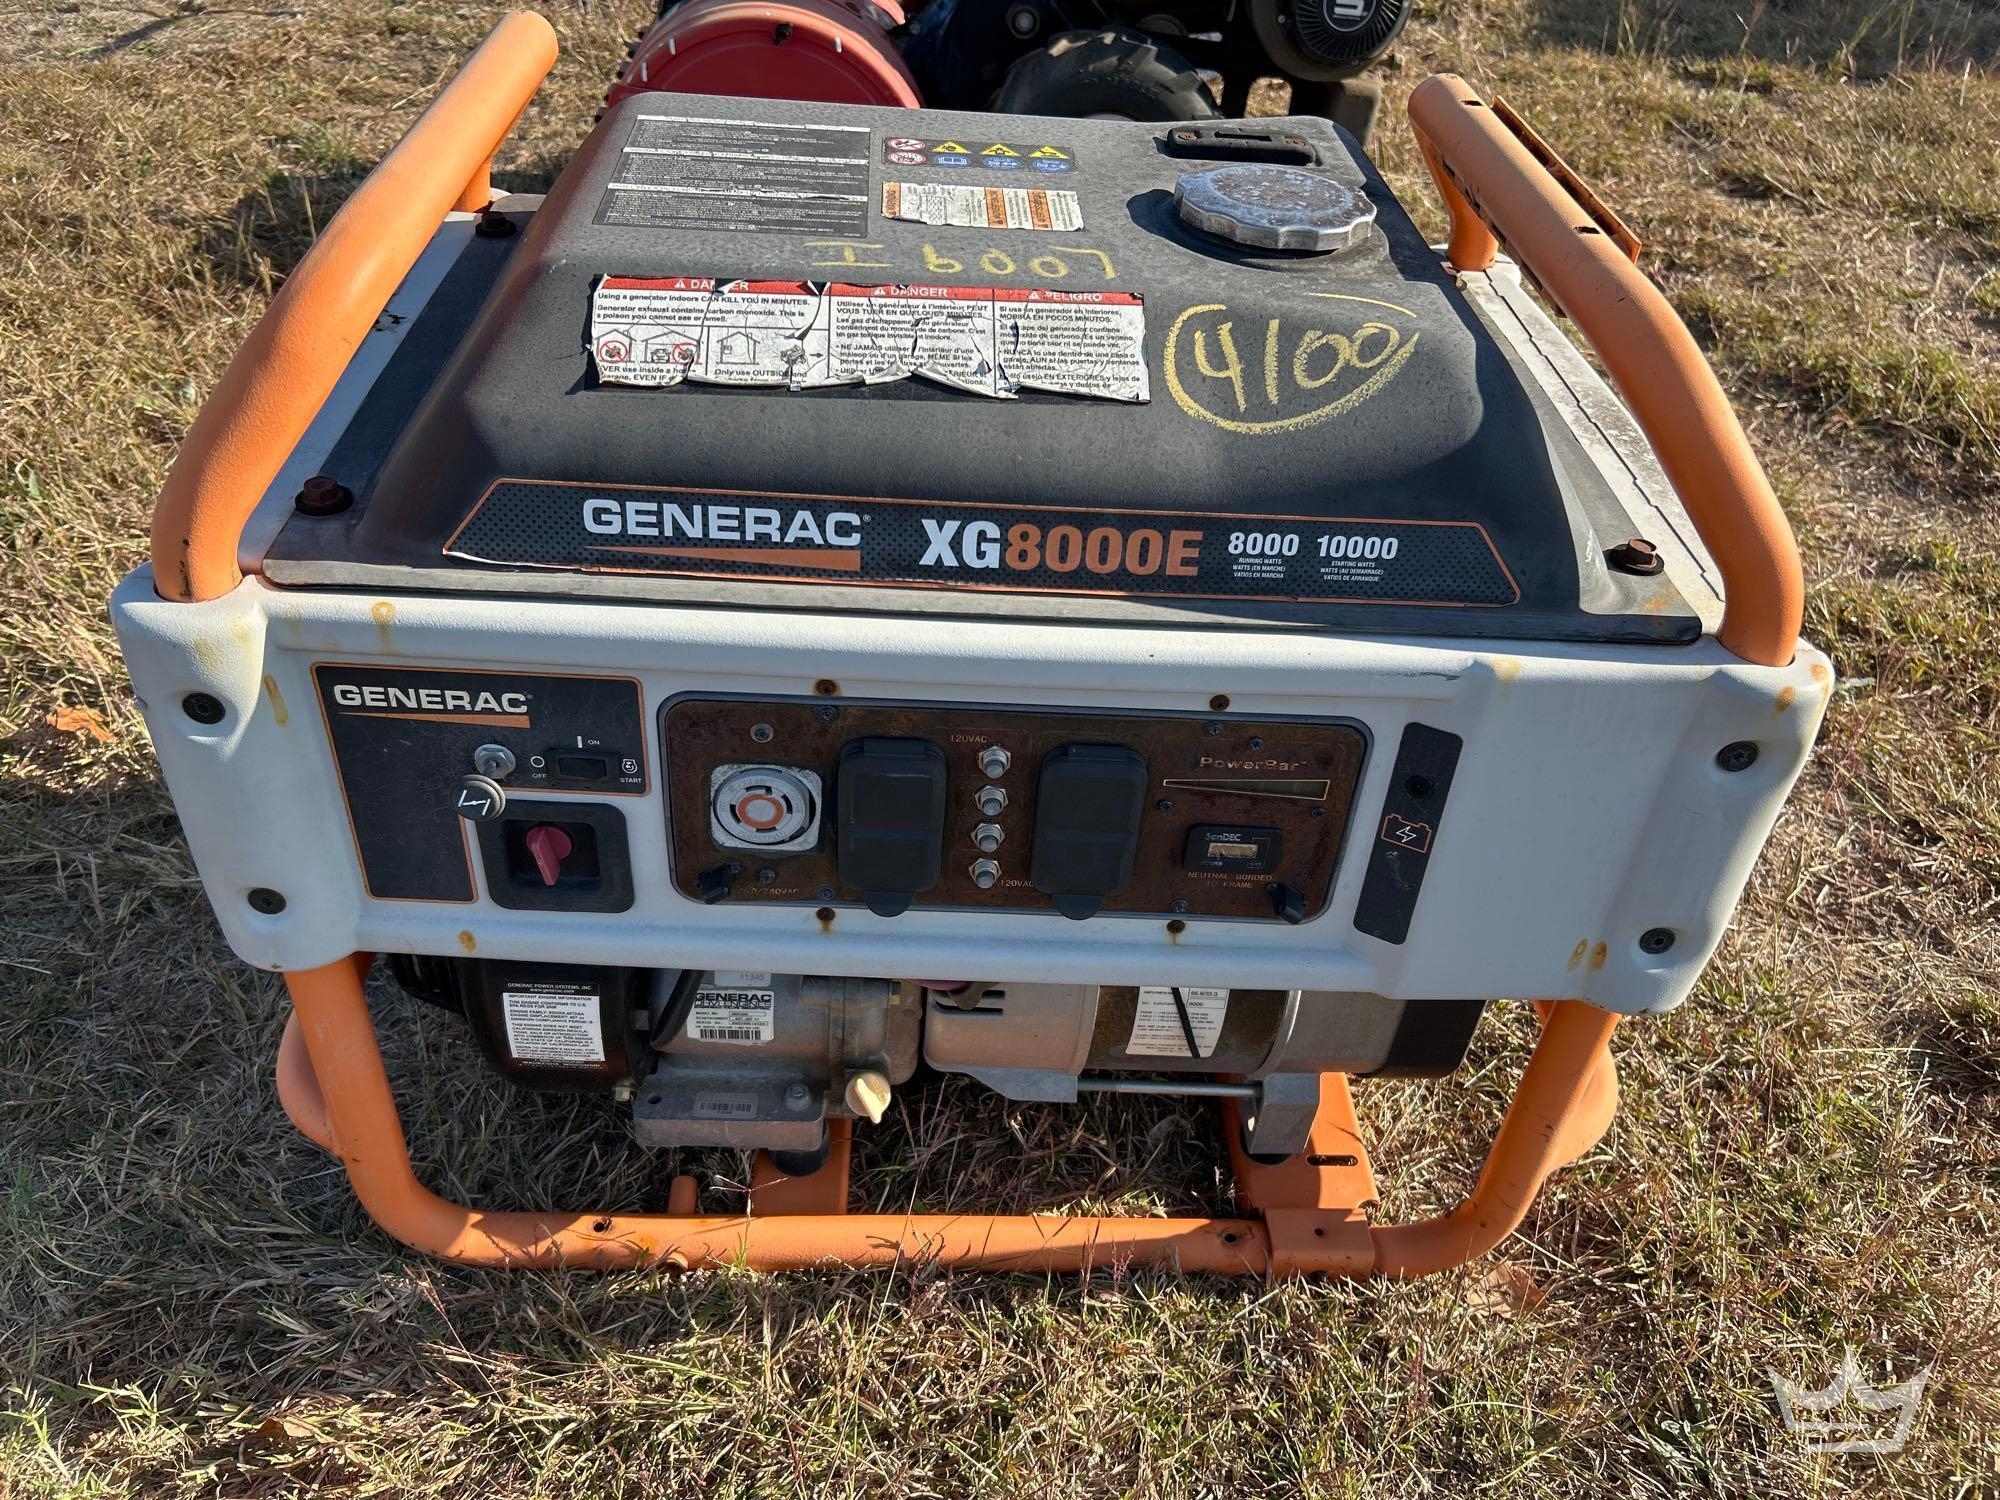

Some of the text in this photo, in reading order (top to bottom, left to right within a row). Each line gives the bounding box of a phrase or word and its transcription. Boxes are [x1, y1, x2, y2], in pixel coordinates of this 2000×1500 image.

[691, 280, 748, 291] DAER
[598, 293, 621, 301] Using
[890, 286, 948, 298] DANGER
[597, 304, 636, 312] Generator
[638, 305, 669, 313] exhaust
[1194, 318, 1400, 413] 4100
[714, 369, 734, 378] Only
[583, 499, 861, 546] GENERAC
[919, 518, 1203, 577] XG8000E
[1228, 532, 1398, 560] 8000 10000
[333, 684, 528, 713] GENERAC
[950, 735, 988, 743] 120VAC
[1205, 832, 1242, 842] SenDEC
[1235, 873, 1272, 881] BONDED
[696, 992, 772, 1003] GENERAC
